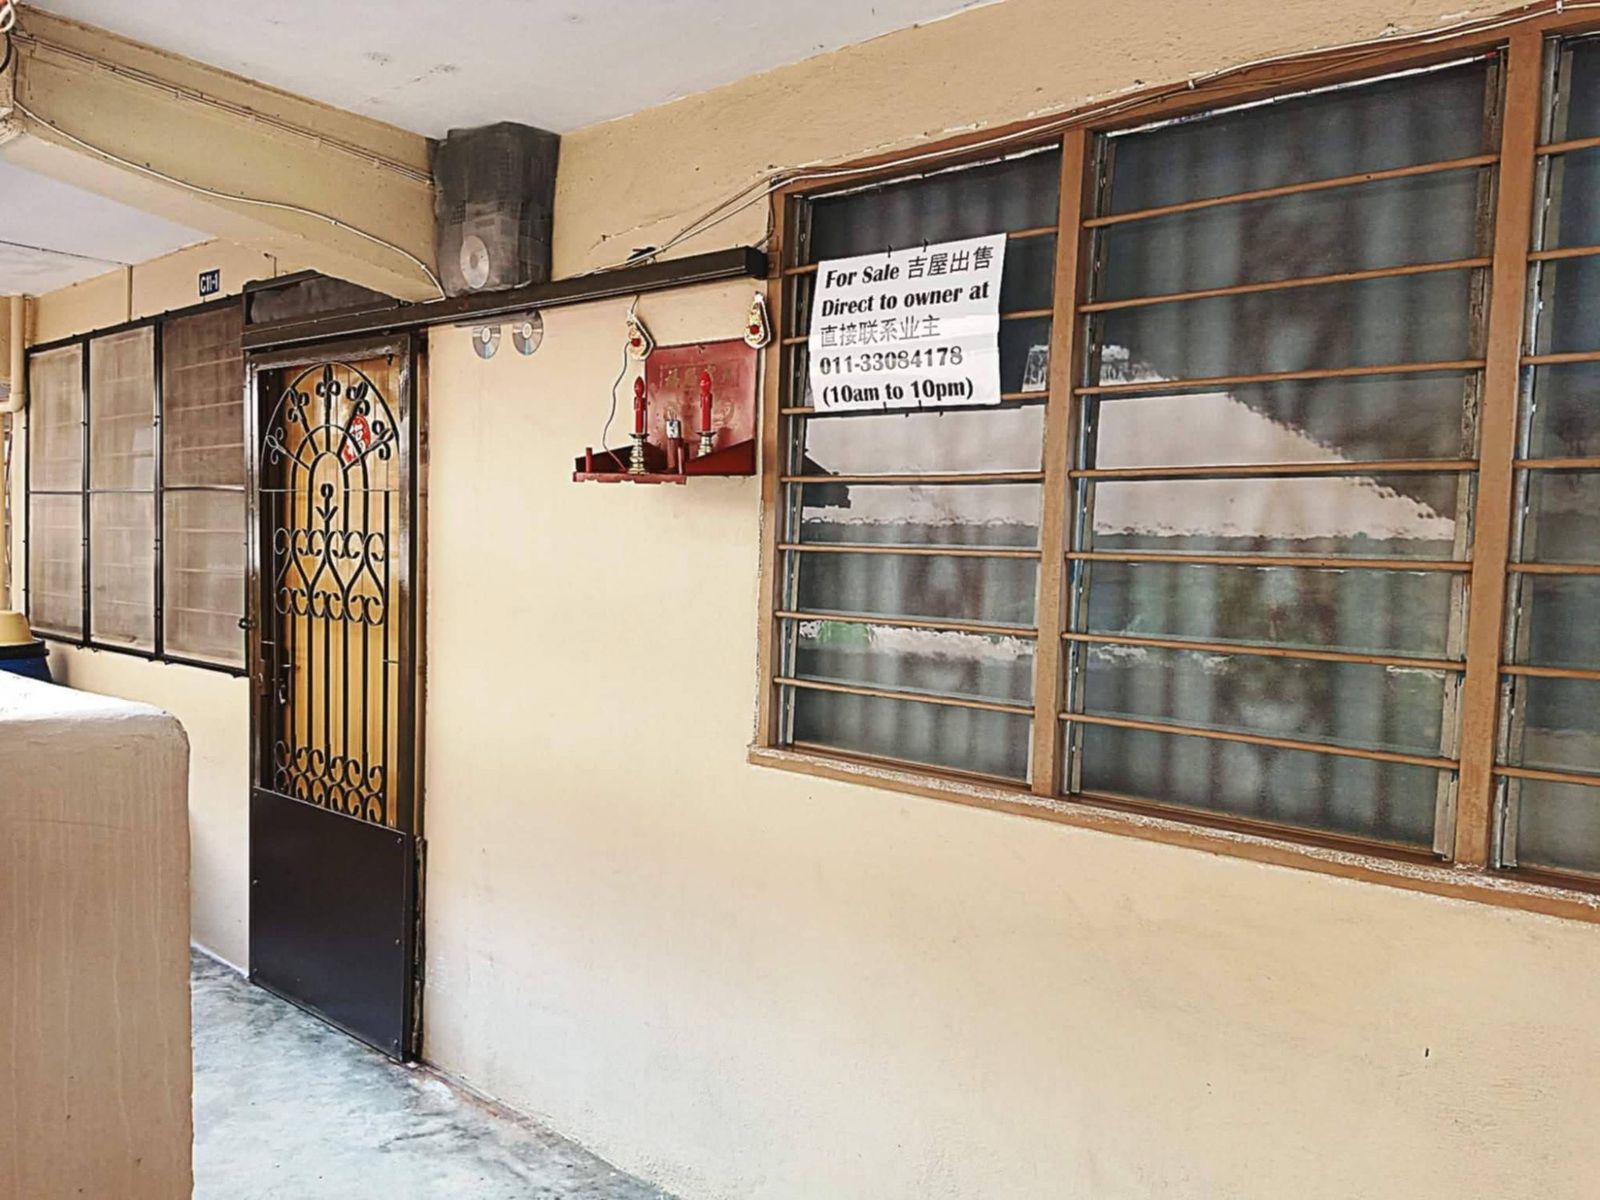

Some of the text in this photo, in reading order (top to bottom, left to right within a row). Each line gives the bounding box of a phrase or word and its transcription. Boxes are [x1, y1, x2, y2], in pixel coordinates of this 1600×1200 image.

[825, 245, 995, 289] For Sale 吉屋出售
[821, 281, 990, 317] Direct to owner at
[820, 314, 941, 348] 直接联系业主
[820, 345, 963, 375] 011-33084178
[822, 377, 974, 407] (10am to 10pm)
